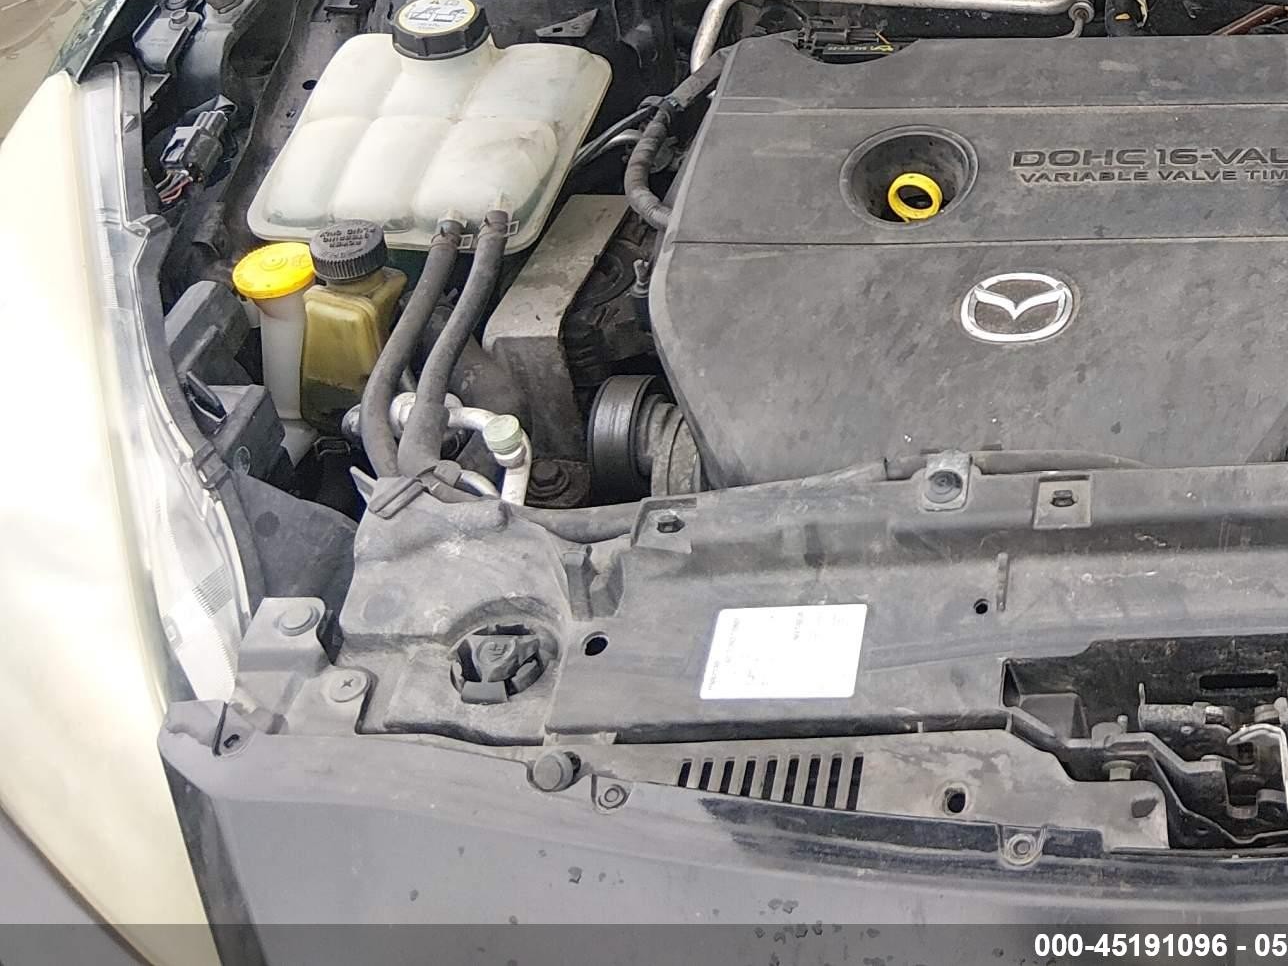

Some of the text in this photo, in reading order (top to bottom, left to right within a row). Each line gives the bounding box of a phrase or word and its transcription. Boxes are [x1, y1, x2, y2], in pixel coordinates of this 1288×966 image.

[1012, 149, 1147, 167] DOHC
[1020, 170, 1149, 183] VARIABLE
[1158, 169, 1238, 181] VALVE
